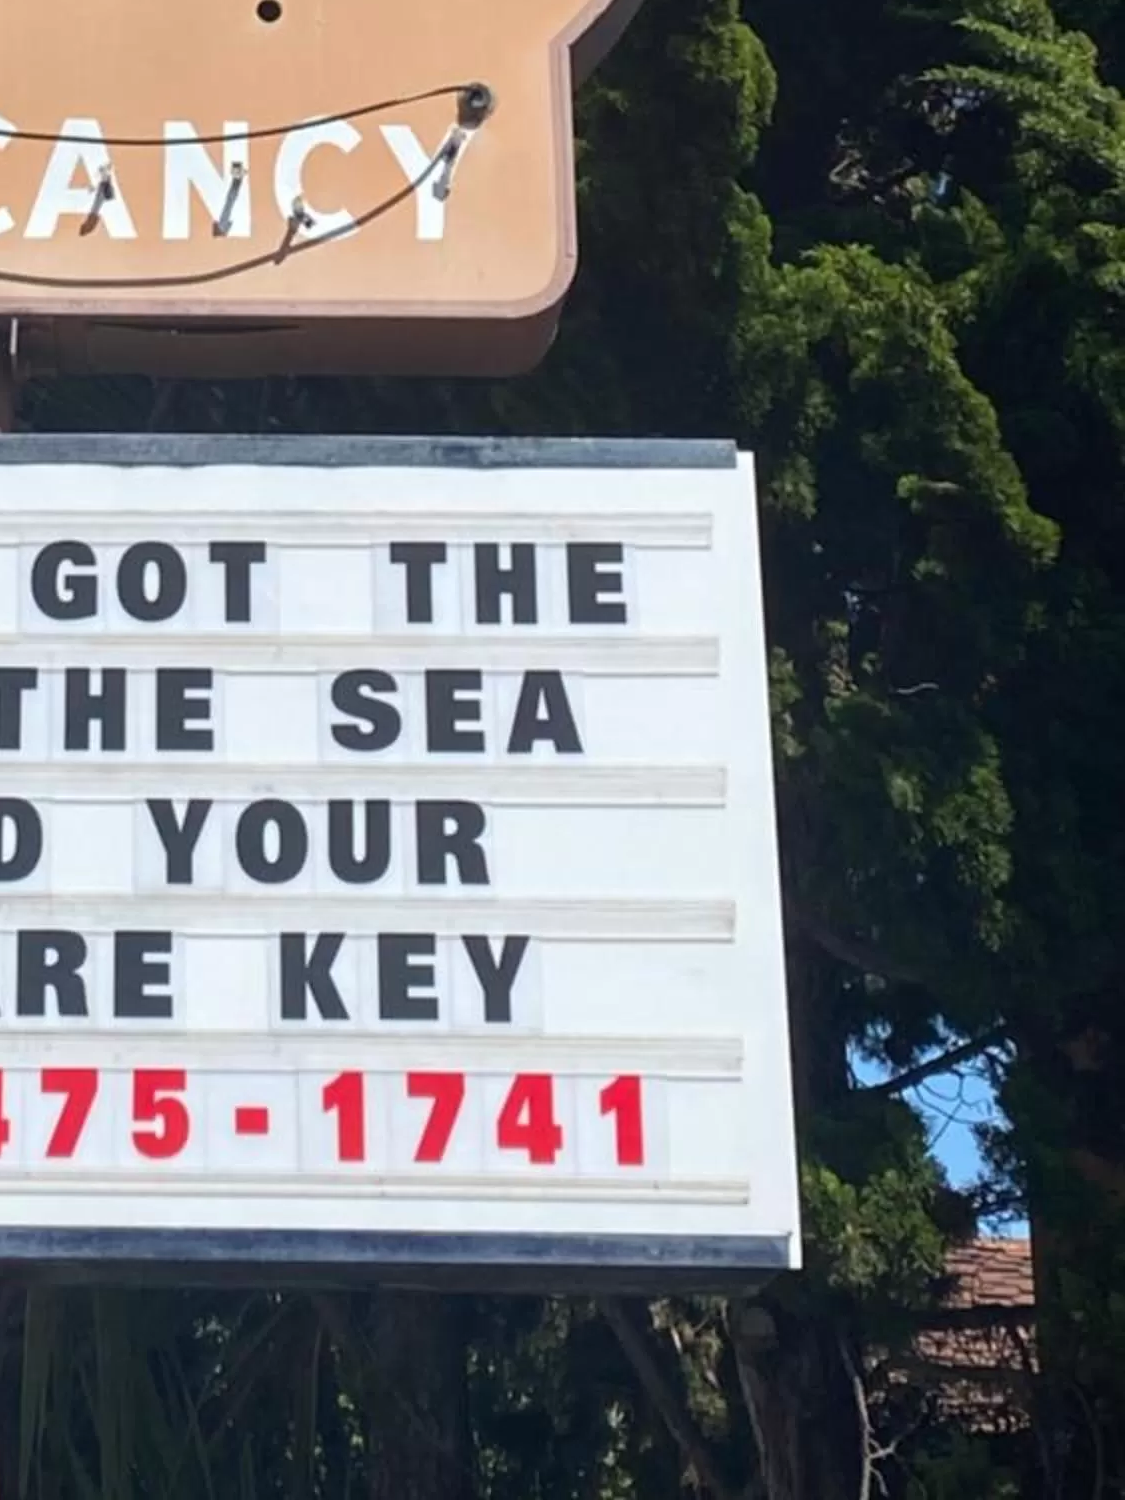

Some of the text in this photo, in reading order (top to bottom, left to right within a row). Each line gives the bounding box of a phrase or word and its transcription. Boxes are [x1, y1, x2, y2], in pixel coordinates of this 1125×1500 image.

[30, 539, 267, 624] GOT
[389, 541, 627, 625] THE
[330, 668, 584, 755] SEA
[146, 798, 491, 886] YOUR
[279, 931, 530, 1023] KEY
